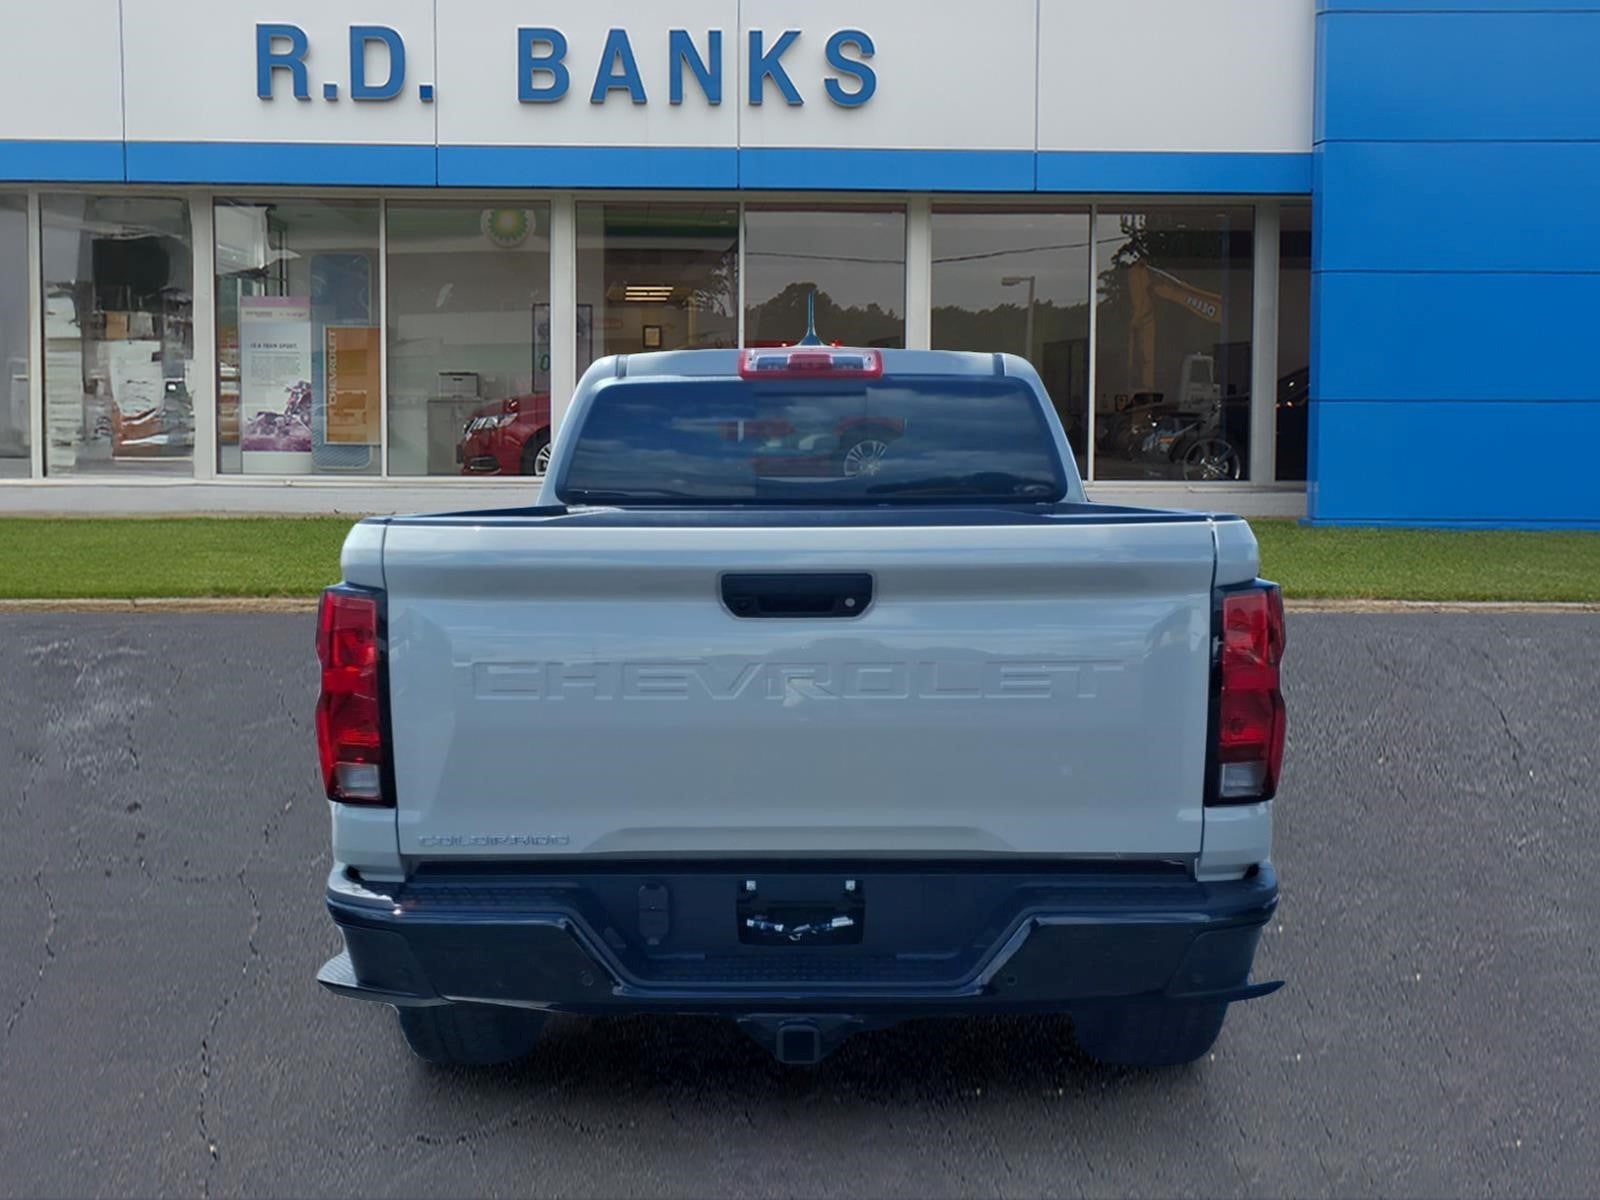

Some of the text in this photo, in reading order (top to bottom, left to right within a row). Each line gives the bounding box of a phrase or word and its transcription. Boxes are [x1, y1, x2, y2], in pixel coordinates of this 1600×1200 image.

[256, 23, 878, 107] R.D. BANKS
[328, 330, 337, 406] CHEVROLET
[472, 659, 1126, 702] CHEVROLET
[418, 833, 570, 848] COLORADO
